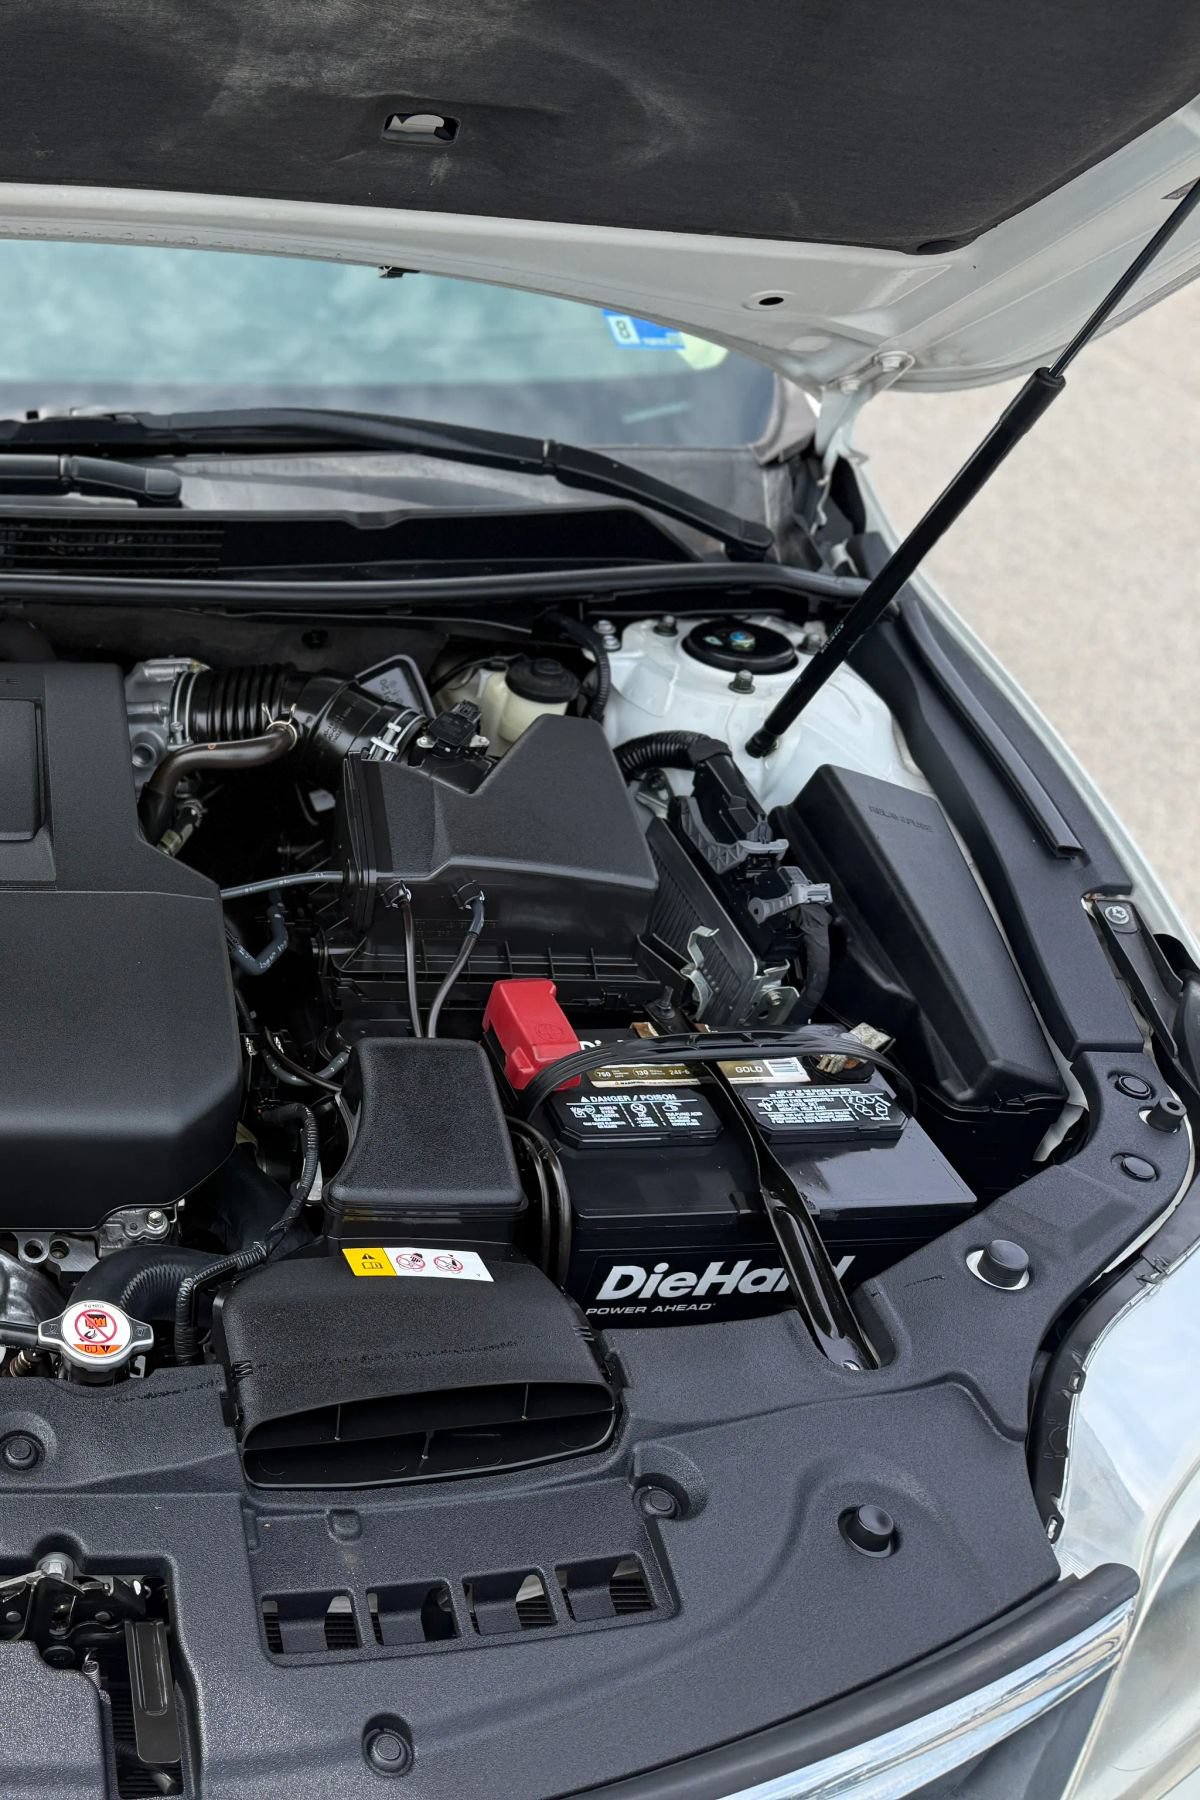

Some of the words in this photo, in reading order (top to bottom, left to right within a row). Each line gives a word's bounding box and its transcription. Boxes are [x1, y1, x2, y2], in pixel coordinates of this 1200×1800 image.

[640, 1093, 677, 1101] POISON
[585, 1306, 647, 1315] POWER
[651, 1303, 712, 1313] AHEAD
